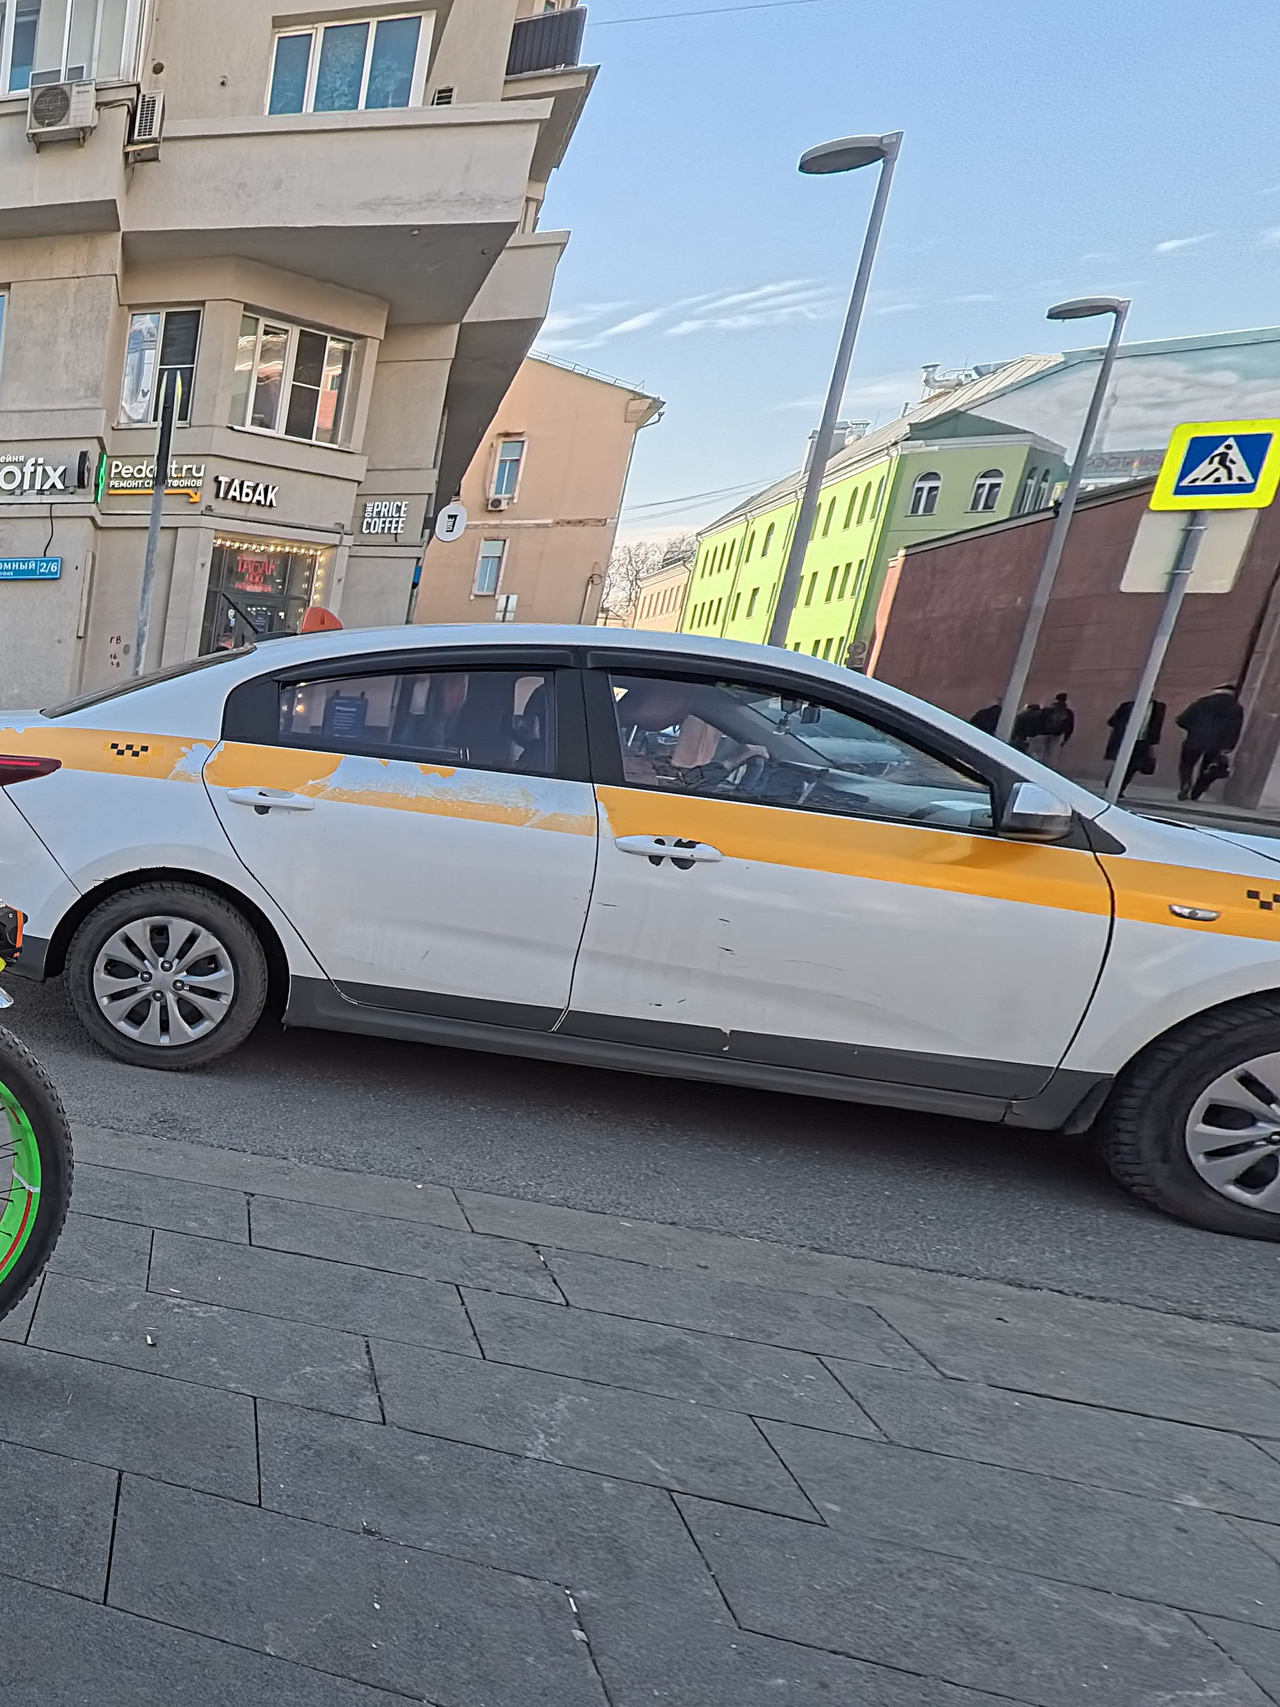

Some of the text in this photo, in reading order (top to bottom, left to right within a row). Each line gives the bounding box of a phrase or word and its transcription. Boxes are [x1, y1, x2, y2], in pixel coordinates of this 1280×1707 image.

[110, 459, 205, 478] Pedat.ru
[109, 479, 203, 488] РЕМОНТ.СТФОНОВ
[218, 475, 280, 507] ТАБАК
[365, 501, 409, 517] ONE PRICE
[362, 518, 406, 534] COFFEE
[40, 562, 57, 572] 2/6
